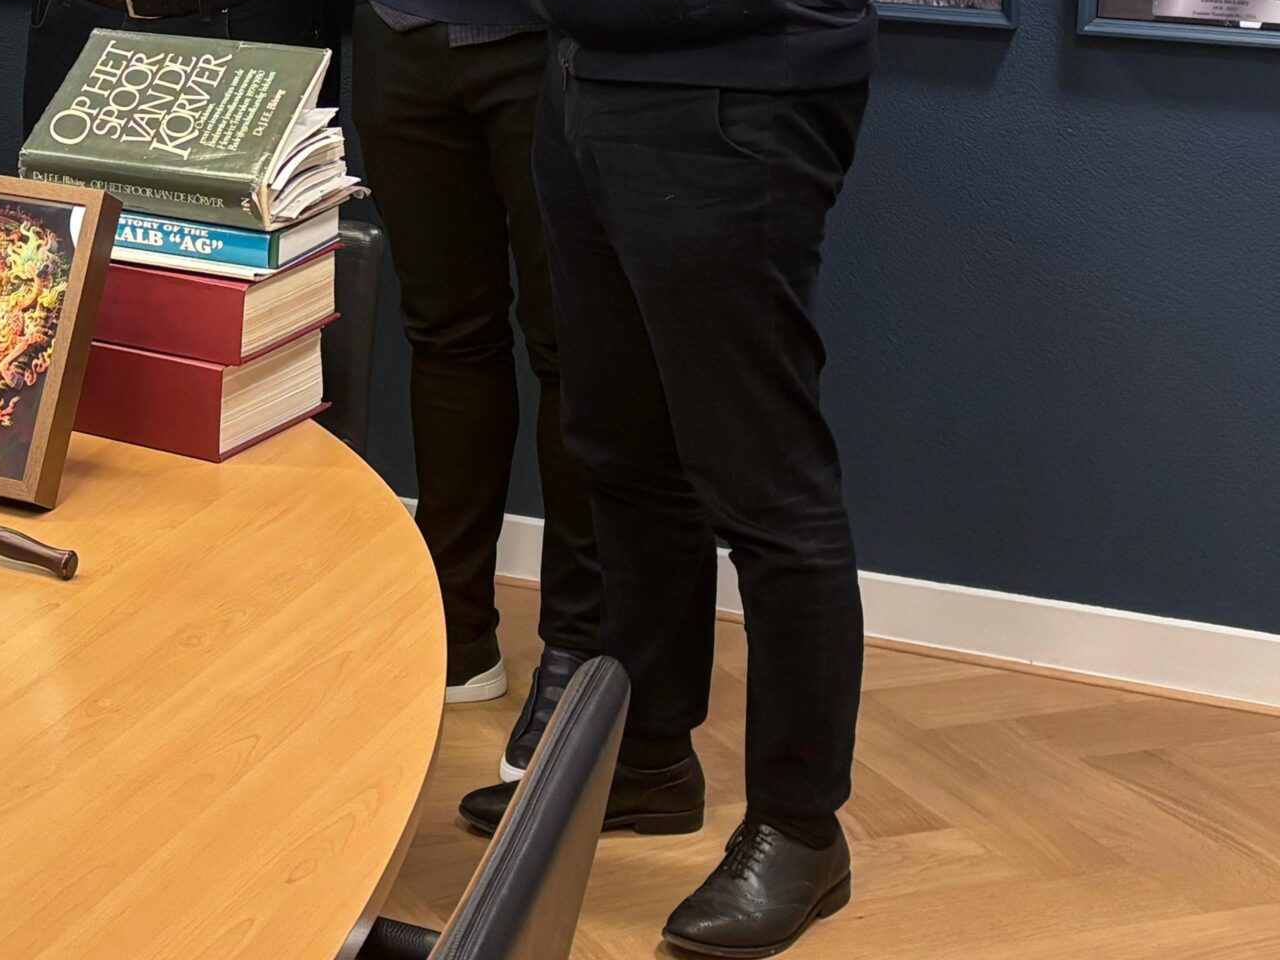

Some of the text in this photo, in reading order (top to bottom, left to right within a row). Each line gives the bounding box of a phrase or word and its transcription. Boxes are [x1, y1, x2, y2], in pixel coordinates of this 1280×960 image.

[49, 40, 134, 145] OP HET
[92, 53, 165, 139] SPOOR
[120, 53, 197, 143] VAN DE
[90, 180, 103, 189] OP
[104, 181, 123, 192] HET
[123, 184, 154, 198] SPOOR
[153, 189, 173, 200] VAN
[174, 192, 188, 202] DE
[115, 226, 164, 246] ALB
[163, 224, 182, 233] OF
[183, 227, 209, 238] THE
